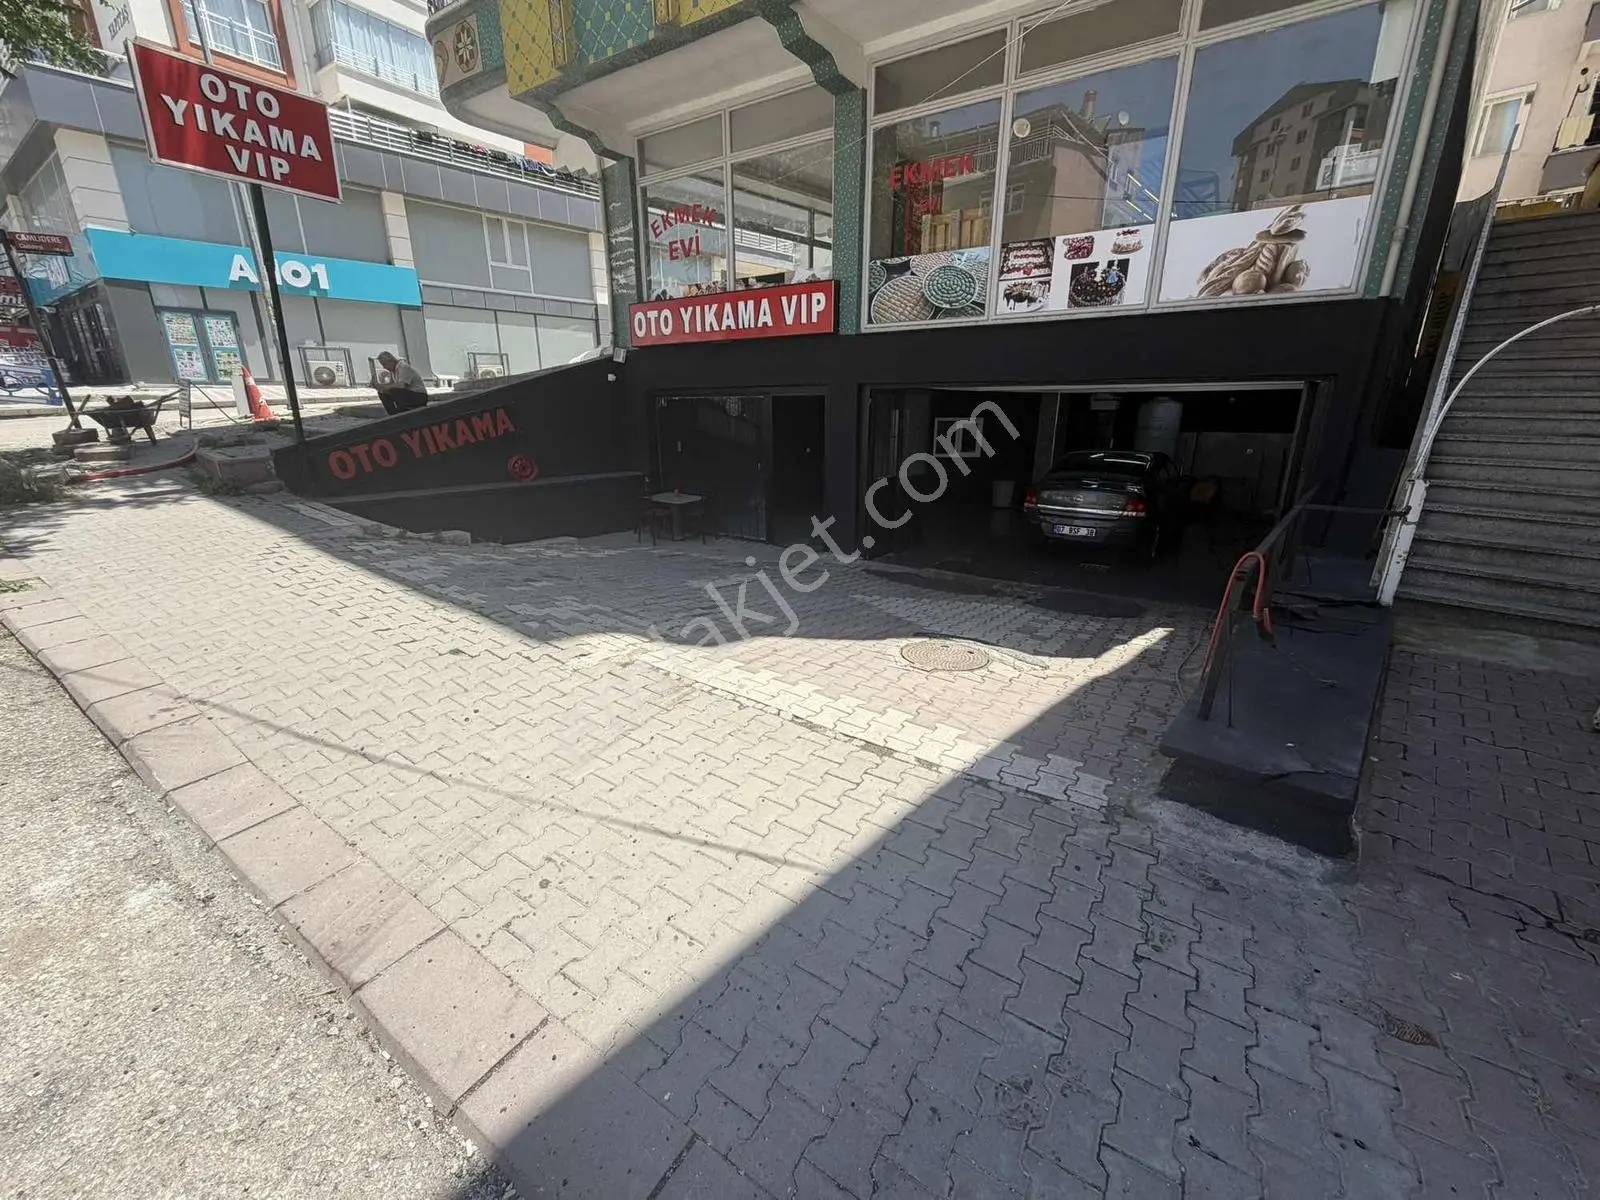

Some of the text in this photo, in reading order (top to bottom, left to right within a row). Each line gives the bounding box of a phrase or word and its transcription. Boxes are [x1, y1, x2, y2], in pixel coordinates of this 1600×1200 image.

[200, 73, 281, 120] OTO
[160, 93, 322, 162] YIKAMA
[224, 144, 291, 182] VIP
[650, 203, 717, 239] EKMEK
[668, 228, 701, 261] EVİ
[633, 292, 826, 338] OTO YIKAMA VIP
[327, 408, 516, 480] OTO YIKAMA
